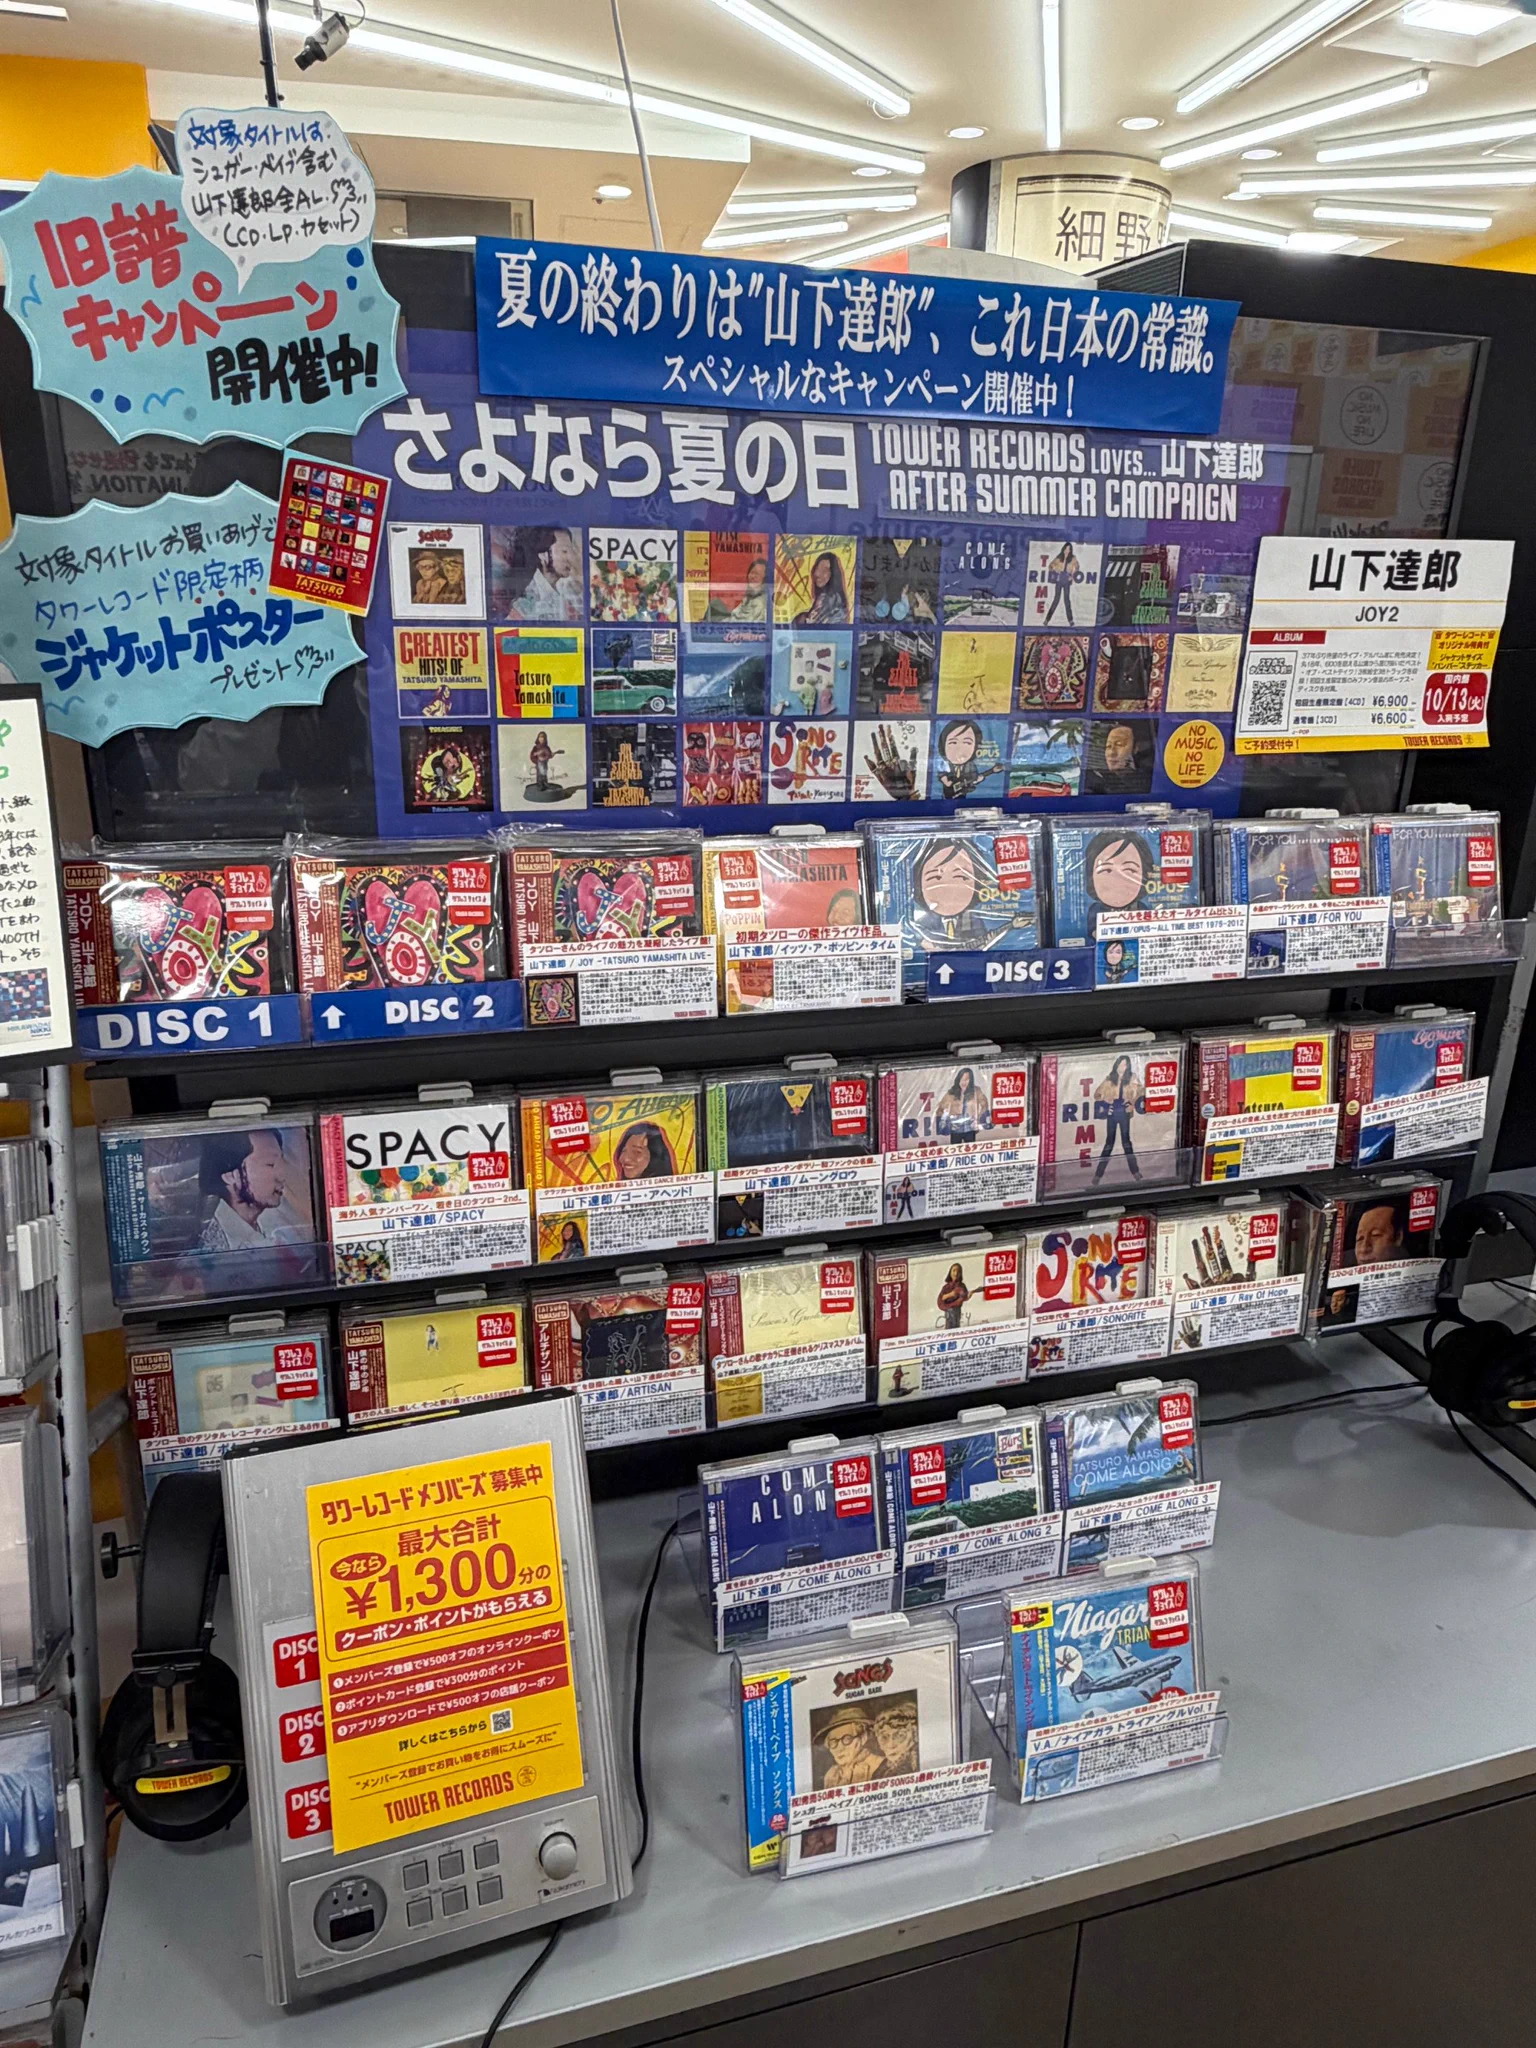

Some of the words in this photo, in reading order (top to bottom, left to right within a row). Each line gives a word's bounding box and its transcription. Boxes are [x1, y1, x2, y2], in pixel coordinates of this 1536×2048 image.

[34, 199, 189, 289] 旧譜
[62, 270, 339, 362] キャンペーン
[206, 332, 380, 406] 開催中!
[662, 353, 1075, 419] スペシャルなキャンペーン開催中!
[382, 397, 860, 510] さよなら夏の日
[868, 421, 961, 470] TOWER
[969, 427, 1085, 475] RECORDS
[1160, 439, 1265, 482] 山下達郎
[889, 469, 968, 514] AFTER
[975, 472, 1098, 518] SUMMER
[1104, 479, 1238, 522] CAMPAIGN
[588, 536, 678, 561] SPACY
[965, 541, 1007, 555] COME
[957, 556, 1011, 570] ALONG
[1309, 546, 1463, 593] 山下達郎
[1354, 605, 1400, 623] JOY2
[35, 597, 326, 692] ジャケットポスター
[400, 631, 481, 664] GREATEST
[1273, 632, 1304, 642] ALBUM
[210, 656, 293, 695] プレゼント
[402, 676, 438, 684] TATSURO
[439, 676, 484, 684] YAMASHITA
[513, 670, 552, 686] Tatsuro
[514, 689, 566, 704] Yamashita
[1373, 695, 1409, 707] ¥6,900
[1425, 686, 1485, 713] 10/13(火)
[1371, 713, 1407, 724] ¥6,600
[1188, 726, 1207, 736] NO
[1403, 736, 1430, 747] TOWER
[1430, 735, 1464, 746] RECORDS
[1244, 739, 1300, 750] ご予約受付中!
[1186, 752, 1203, 762] NO
[517, 855, 550, 863] TATSURO
[527, 877, 539, 911] JOY
[1171, 923, 1186, 932] TIME
[1188, 923, 1205, 932] BEST
[1345, 911, 1362, 922] YOU
[736, 926, 888, 942] 初期タツローの傑作ライヴ作品。
[530, 960, 566, 970] 山下達郎
[578, 957, 594, 967] JOY
[643, 952, 687, 962] YAMASHITA
[985, 960, 1045, 983] DISC
[1053, 960, 1071, 981] 3
[385, 997, 460, 1025] DISC
[473, 994, 495, 1019] 2
[97, 1005, 230, 1049] DISC
[248, 1002, 273, 1037] 1
[346, 1120, 507, 1170] SPACY
[905, 1155, 976, 1173] 山下達郎/RIDE
[980, 1154, 994, 1163] ON
[998, 1151, 1020, 1161] TIME
[745, 1170, 858, 1190] 山下達郎/ムーングロウ
[563, 1186, 693, 1210] 山下達郎/ゴー・アヘッド!
[382, 1209, 485, 1230] 山下達郎/SPACY
[335, 1240, 389, 1256] SPACY
[893, 1285, 902, 1318] コージー
[1191, 1297, 1227, 1310] 山下達郎
[1238, 1292, 1251, 1303] Ray
[1254, 1289, 1265, 1300] Of
[1268, 1287, 1288, 1300] Hope
[1057, 1311, 1146, 1332] 山下達郎/SONORITE
[915, 1341, 958, 1356] 山下達郎
[971, 1335, 997, 1347] COZY
[348, 1350, 361, 1391] 山下達郎
[134, 1378, 150, 1420] 山下達郎
[761, 1463, 834, 1496] COME
[1073, 1469, 1118, 1488] COME
[1122, 1457, 1172, 1478] ALONG
[321, 1487, 414, 1525] タワーレコード
[419, 1470, 487, 1508] メンバーズ
[490, 1463, 544, 1493] 募集中
[1079, 1511, 1122, 1530] 山下達郎
[1135, 1504, 1164, 1518] COME
[1166, 1497, 1199, 1511] ALONG
[1202, 1494, 1209, 1505] 3
[398, 1513, 501, 1557] 最大合計
[914, 1545, 960, 1562] 山下達郎
[974, 1536, 1004, 1550] COME
[1007, 1528, 1041, 1542] ALONG
[1045, 1525, 1052, 1536] 2
[336, 1556, 382, 1578] 今なら
[732, 1583, 782, 1603] 山下達郎
[798, 1574, 830, 1588] COME
[834, 1567, 872, 1580] ALONG
[341, 1589, 548, 1649] クーポン・ポイントがもらえる
[1056, 1599, 1150, 1650] Niagar
[278, 1636, 317, 1660] DISC
[1117, 1627, 1151, 1646] TRIAN
[294, 1659, 306, 1680] 1
[832, 1657, 894, 1697] SONGS
[845, 1690, 865, 1699] SUGAR
[867, 1685, 882, 1695] BABE
[284, 1711, 324, 1735] DISC
[769, 1691, 781, 1763] シュガー・ベイブ
[299, 1734, 316, 1755] 2
[398, 1719, 488, 1752] 詳しくはこちらから
[151, 1774, 178, 1791] TOWER
[179, 1771, 213, 1789] RECORDS
[771, 1771, 783, 1809] ソングス
[891, 1787, 911, 1800] 50th
[913, 1779, 960, 1796] Anniversary
[962, 1773, 989, 1785] Edition
[291, 1787, 330, 1811] DISC
[384, 1792, 440, 1824] TOWER
[442, 1771, 514, 1809] RECORDS
[305, 1810, 321, 1832] 3
